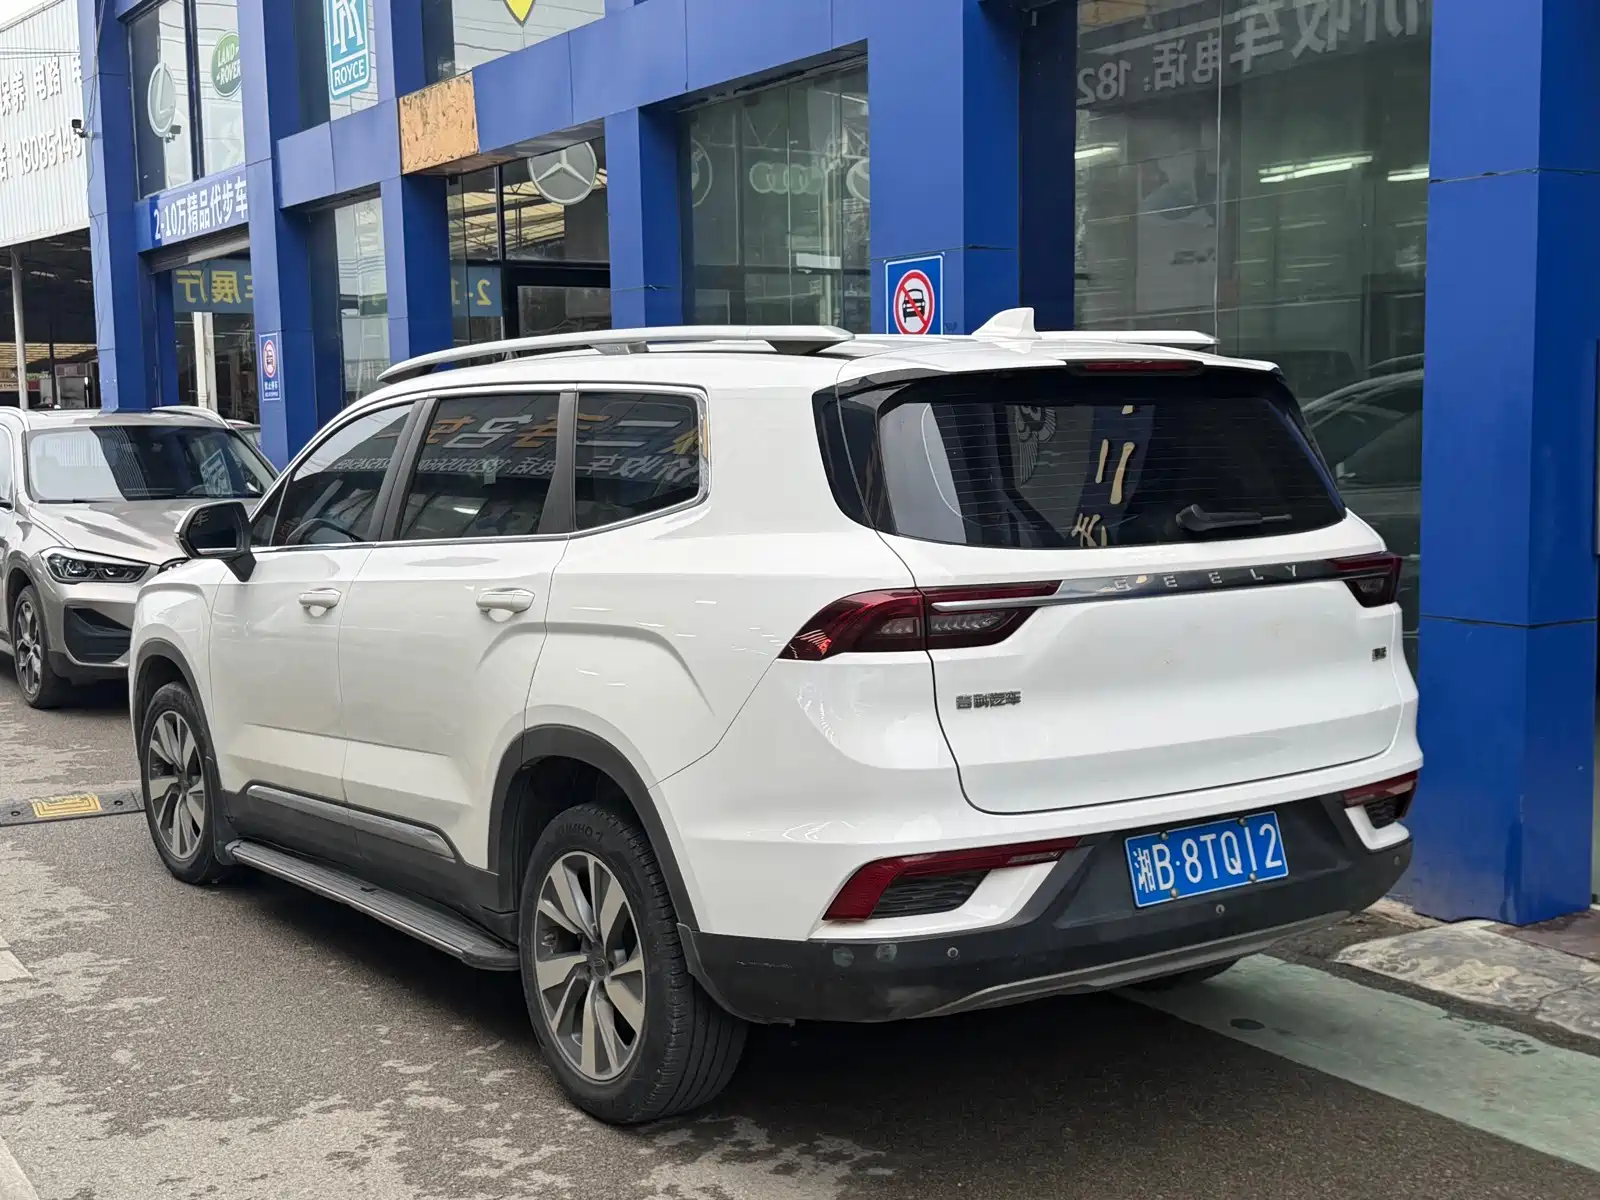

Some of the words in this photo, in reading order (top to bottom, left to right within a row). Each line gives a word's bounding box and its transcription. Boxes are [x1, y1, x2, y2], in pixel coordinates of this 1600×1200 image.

[218, 43, 235, 67] LAND
[334, 59, 365, 87] ROYCE
[1114, 564, 1298, 592] GEELY
